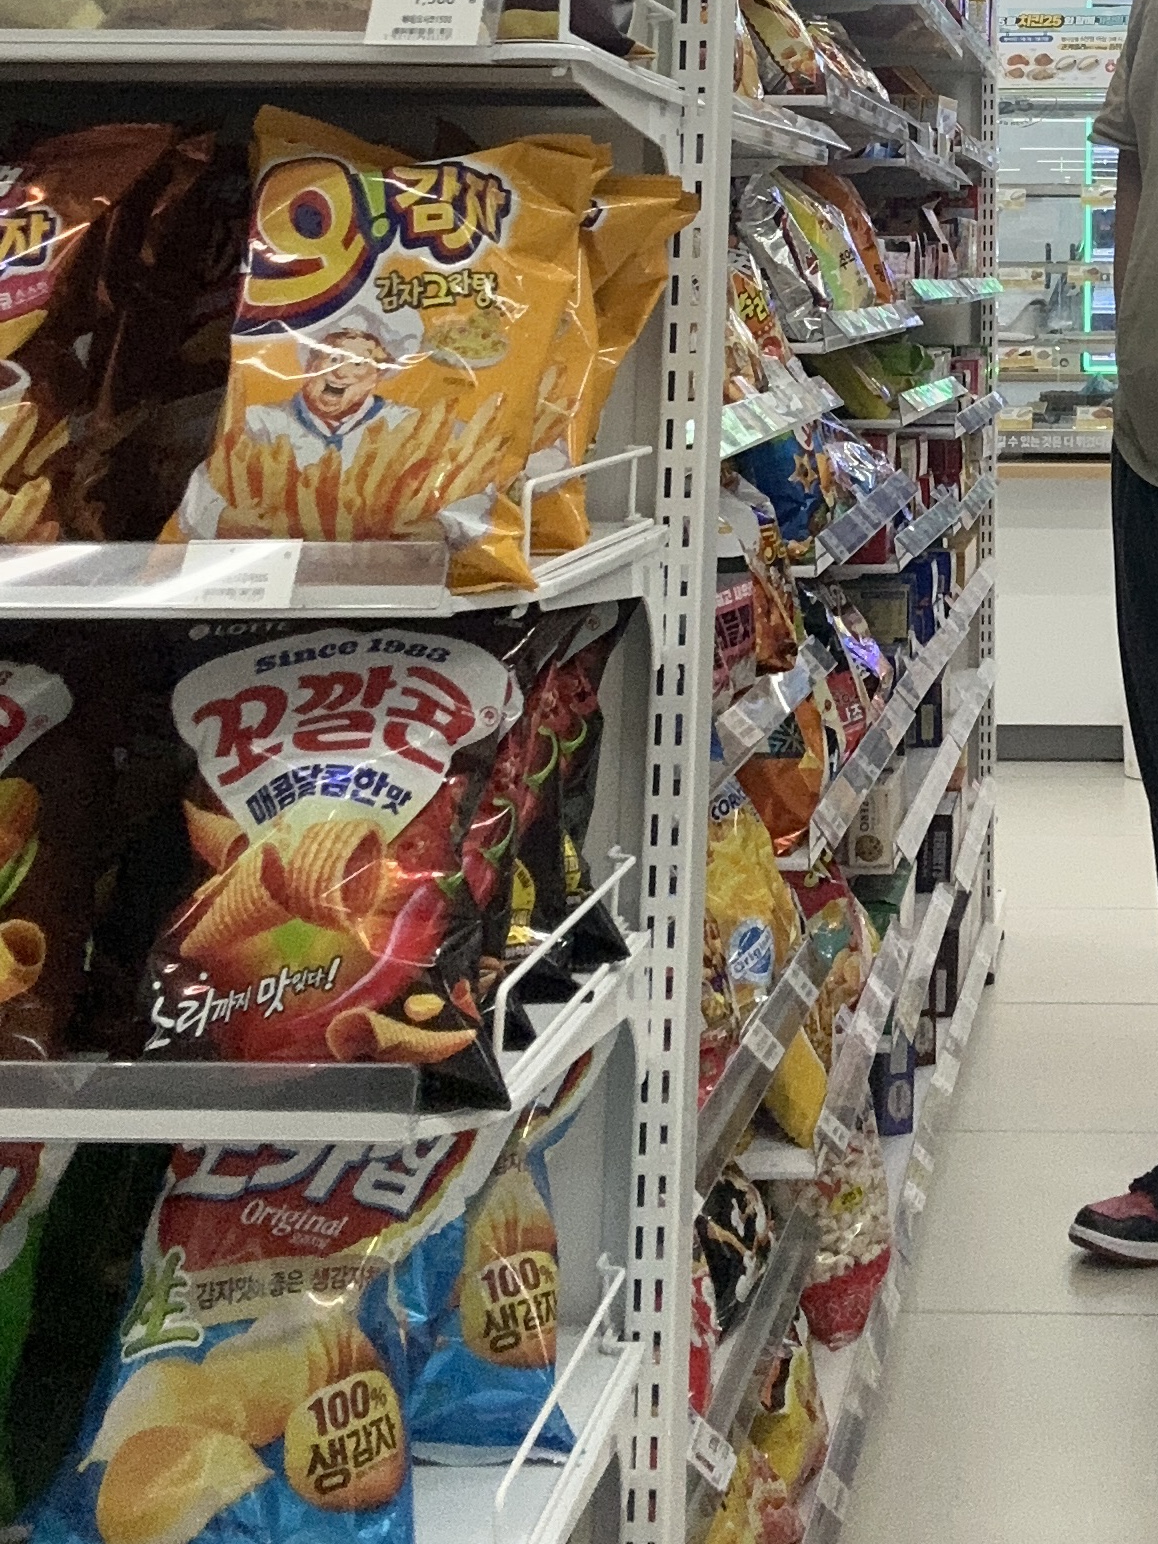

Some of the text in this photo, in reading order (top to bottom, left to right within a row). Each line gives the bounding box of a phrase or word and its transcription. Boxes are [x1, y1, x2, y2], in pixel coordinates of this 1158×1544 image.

[1018, 14, 1063, 29] 치킨25
[234, 158, 510, 334] 오!감자
[374, 270, 499, 313] 감자그라탕
[1008, 435, 1019, 448] 수
[1020, 435, 1040, 449] 있는
[1063, 435, 1074, 449] 다
[253, 639, 359, 675] Since
[192, 665, 476, 787] 꼬깔콘
[244, 763, 413, 826] 매콤달콤한맛
[256, 957, 342, 1019] 맛있다!
[240, 1198, 350, 1238] Original
[269, 1270, 304, 1297] 좋은
[480, 1257, 556, 1304] 100%
[306, 1369, 388, 1438] 100%
[306, 1412, 398, 1496] 생감자
